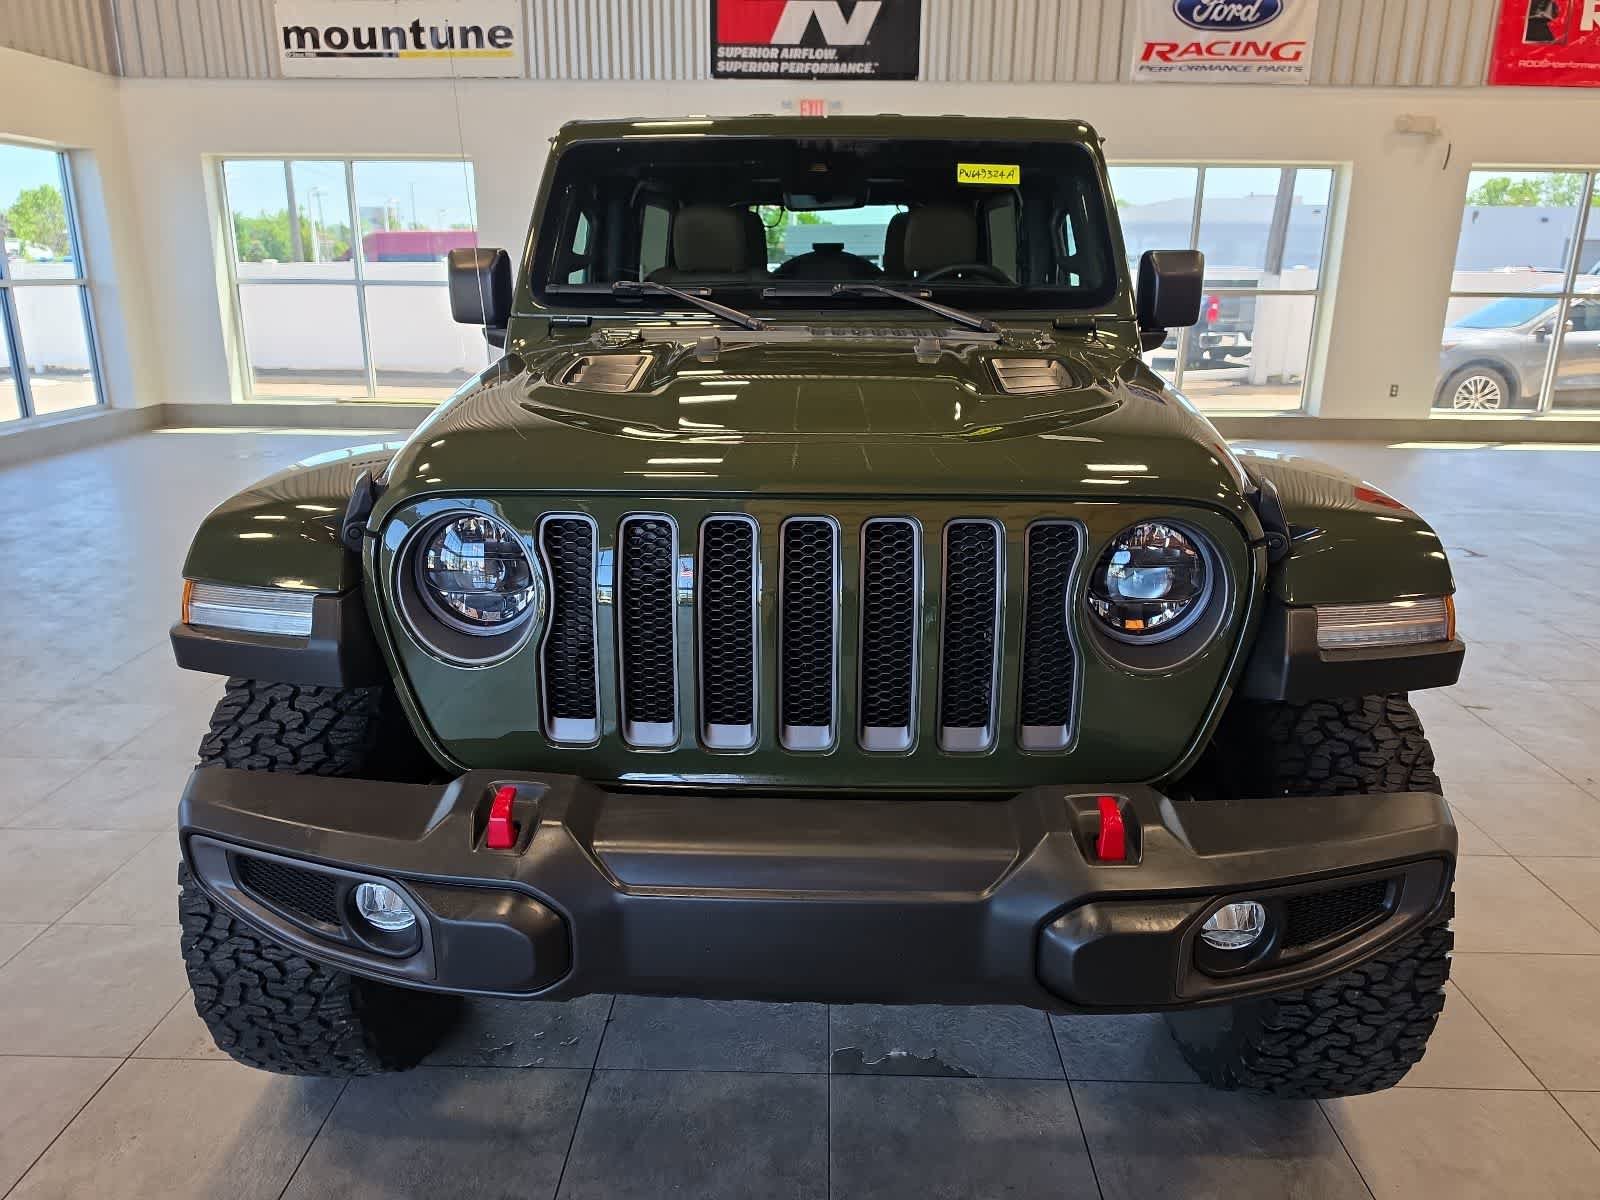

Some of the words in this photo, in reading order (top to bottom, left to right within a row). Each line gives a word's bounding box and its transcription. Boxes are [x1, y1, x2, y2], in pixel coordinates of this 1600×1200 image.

[1192, 0, 1260, 23] Ford
[283, 18, 514, 50] mountune
[716, 46, 778, 59] SUPERIOR
[779, 48, 839, 60] AIRFLOW.
[1141, 41, 1307, 63] RACING
[716, 60, 779, 73] SUPERIOR
[1139, 64, 1252, 73] PERFORMANCE
[1256, 65, 1305, 73] PARTS
